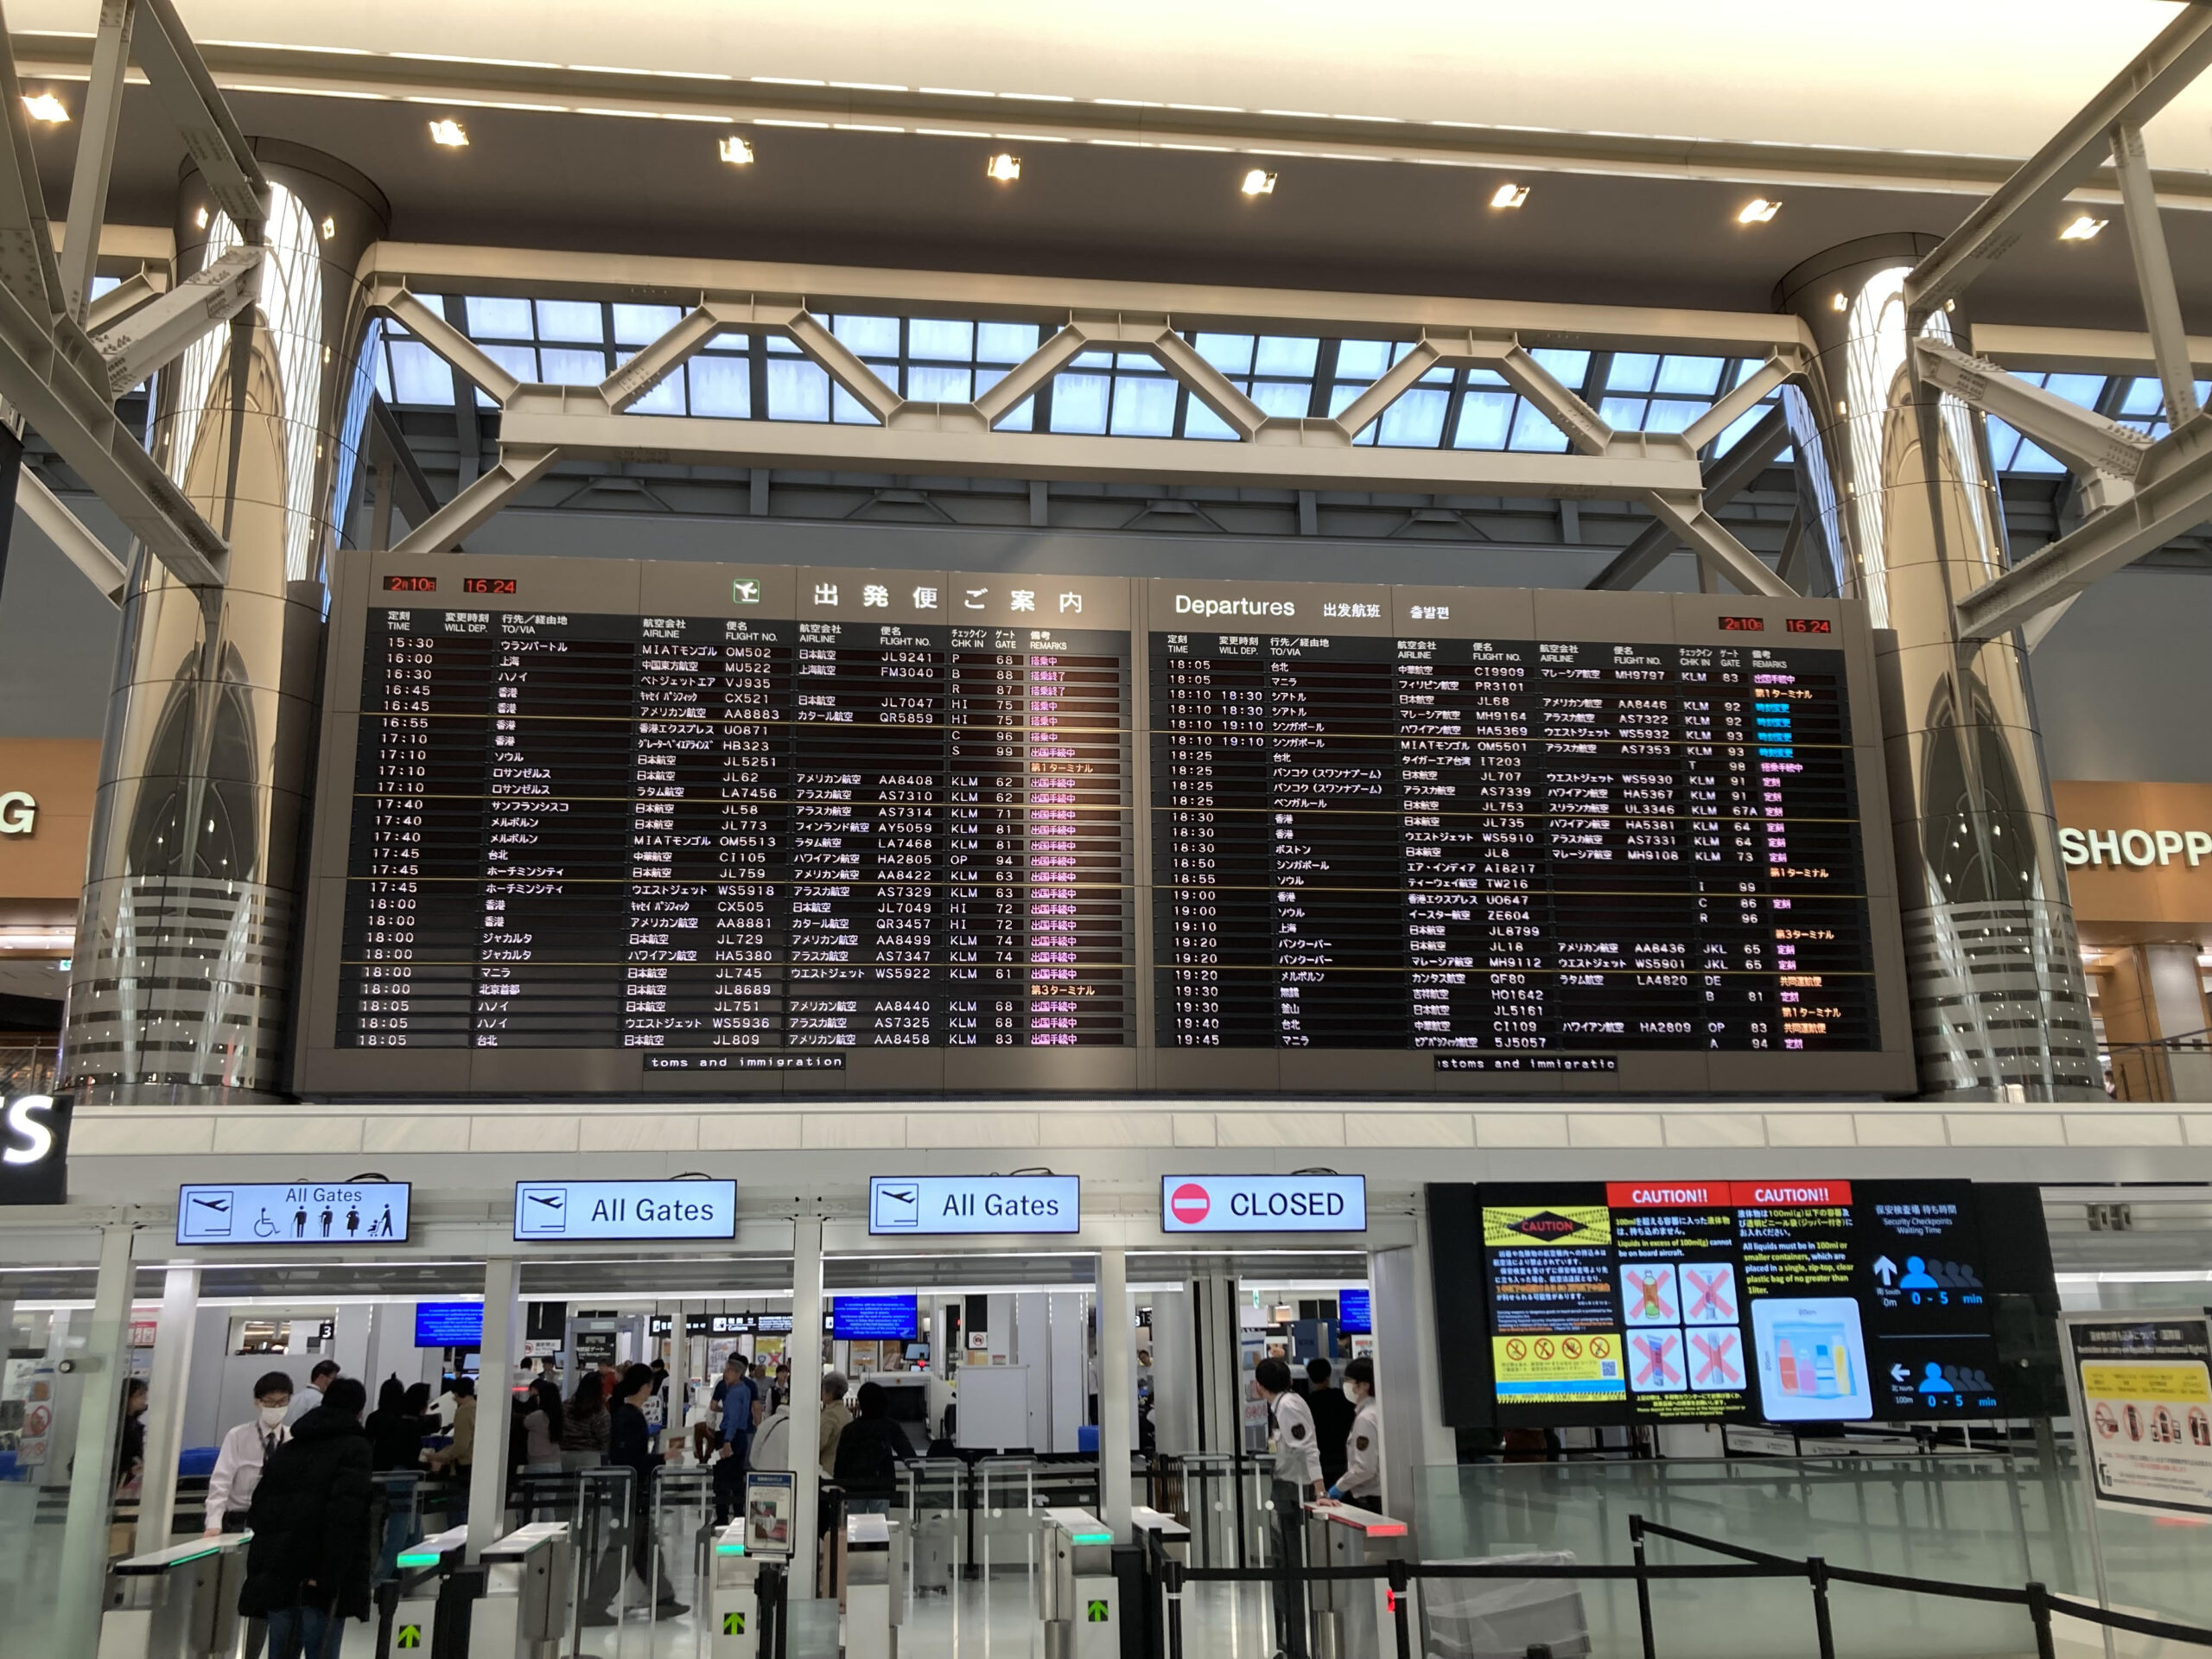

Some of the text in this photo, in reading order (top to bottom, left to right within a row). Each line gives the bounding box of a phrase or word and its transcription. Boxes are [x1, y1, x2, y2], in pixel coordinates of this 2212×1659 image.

[466, 579, 516, 594] 16 24
[814, 582, 1083, 613] 出発便ご案内
[1175, 594, 1295, 618] Departures
[1323, 602, 1382, 619] 出发航班
[1409, 605, 1449, 620] 출발편
[387, 610, 410, 621] 定刻
[444, 612, 490, 624] 変更時刻
[643, 618, 687, 629] 航空会社
[726, 620, 747, 632] 便名
[951, 628, 988, 639] チェックイン
[995, 630, 1015, 639] ゲート
[1030, 631, 1050, 640] 備考
[1787, 620, 1830, 633] 16 24
[386, 620, 1067, 651] TIME WILL DEP. TO/VIA AIRLINE FLIGHT NO. CHK IN GATE REMARKS
[389, 637, 434, 649] 15:30
[500, 640, 569, 652] ウランバートル
[726, 646, 772, 658] OM502
[798, 649, 836, 661] 日本航空
[881, 652, 931, 663] JL9241
[952, 653, 960, 664] P
[996, 655, 1013, 665] 68
[1169, 659, 1211, 670] 18:05
[1270, 662, 1289, 672] 台北
[1397, 664, 1433, 676] 中華航空
[1474, 666, 1525, 677] CI9909
[1541, 669, 1601, 679] マレーシア航空
[1615, 670, 1665, 681] MH9797
[1681, 671, 1707, 682] KLM
[1722, 672, 1738, 683] 83
[1170, 689, 1211, 700] 18:10
[1221, 690, 1262, 701] 18:30
[1271, 692, 1307, 702] シアトル
[1399, 694, 1435, 705] 日本航空
[1477, 696, 1510, 707] JL68
[1542, 697, 1603, 709] アメリカン航空
[1618, 699, 1668, 710] AA8446
[1683, 701, 1709, 711] KLM
[1724, 702, 1741, 712] 92
[379, 765, 1076, 788] 17:10 ロサンゼルス 日本航空 JL62 アメリカン航空 AA8408 KLM 62 出国手続中
[0, 791, 37, 834] G
[2058, 827, 2212, 867] SHOPP
[1175, 953, 1217, 964] 19:20
[1411, 956, 1474, 968] マレーシア航空
[1489, 957, 1541, 969] MH9112
[1558, 957, 1627, 969] ウエストジェット
[1635, 958, 1685, 969] WS5901
[1704, 959, 1729, 969] JKL
[1745, 959, 1763, 970] 65
[364, 966, 1077, 980] 18:00 マニラ 日本航空 JL745 ウエストジェット WS5922 KLM 61 出国手続中
[652, 1057, 842, 1067] toms and immigration
[1495, 1058, 1520, 1068] and
[0, 1095, 54, 1164] S
[285, 1188, 362, 1203] All Gates
[1632, 1189, 1708, 1204] CAUTION!!
[1755, 1187, 1830, 1203] CAUTION!!
[591, 1198, 714, 1222] All Gates
[942, 1193, 1059, 1217] All Gates
[1230, 1192, 1344, 1217] CLOSED
[1521, 1221, 1573, 1231] CAUTION
[1883, 1217, 1953, 1227] Security Checkpoints
[1897, 1226, 1942, 1236] Waiting Time
[1618, 1239, 1641, 1248] Liquids
[1743, 1243, 1752, 1251] All
[1753, 1243, 1778, 1252] liquids
[1744, 1253, 1770, 1262] smaller
[1811, 1252, 1833, 1261] which
[1745, 1264, 1769, 1274] placed
[1770, 1263, 1777, 1272] in
[1746, 1275, 1770, 1284] plastic
[1770, 1275, 1784, 1284] bag
[1785, 1274, 1793, 1283] of
[1805, 1275, 1830, 1284] greater
[1883, 1298, 1897, 1307] 0m
[1911, 1291, 1983, 1305] 0 5 min
[322, 1325, 332, 1338] 3
[1928, 1394, 1997, 1408] 0 5 min
